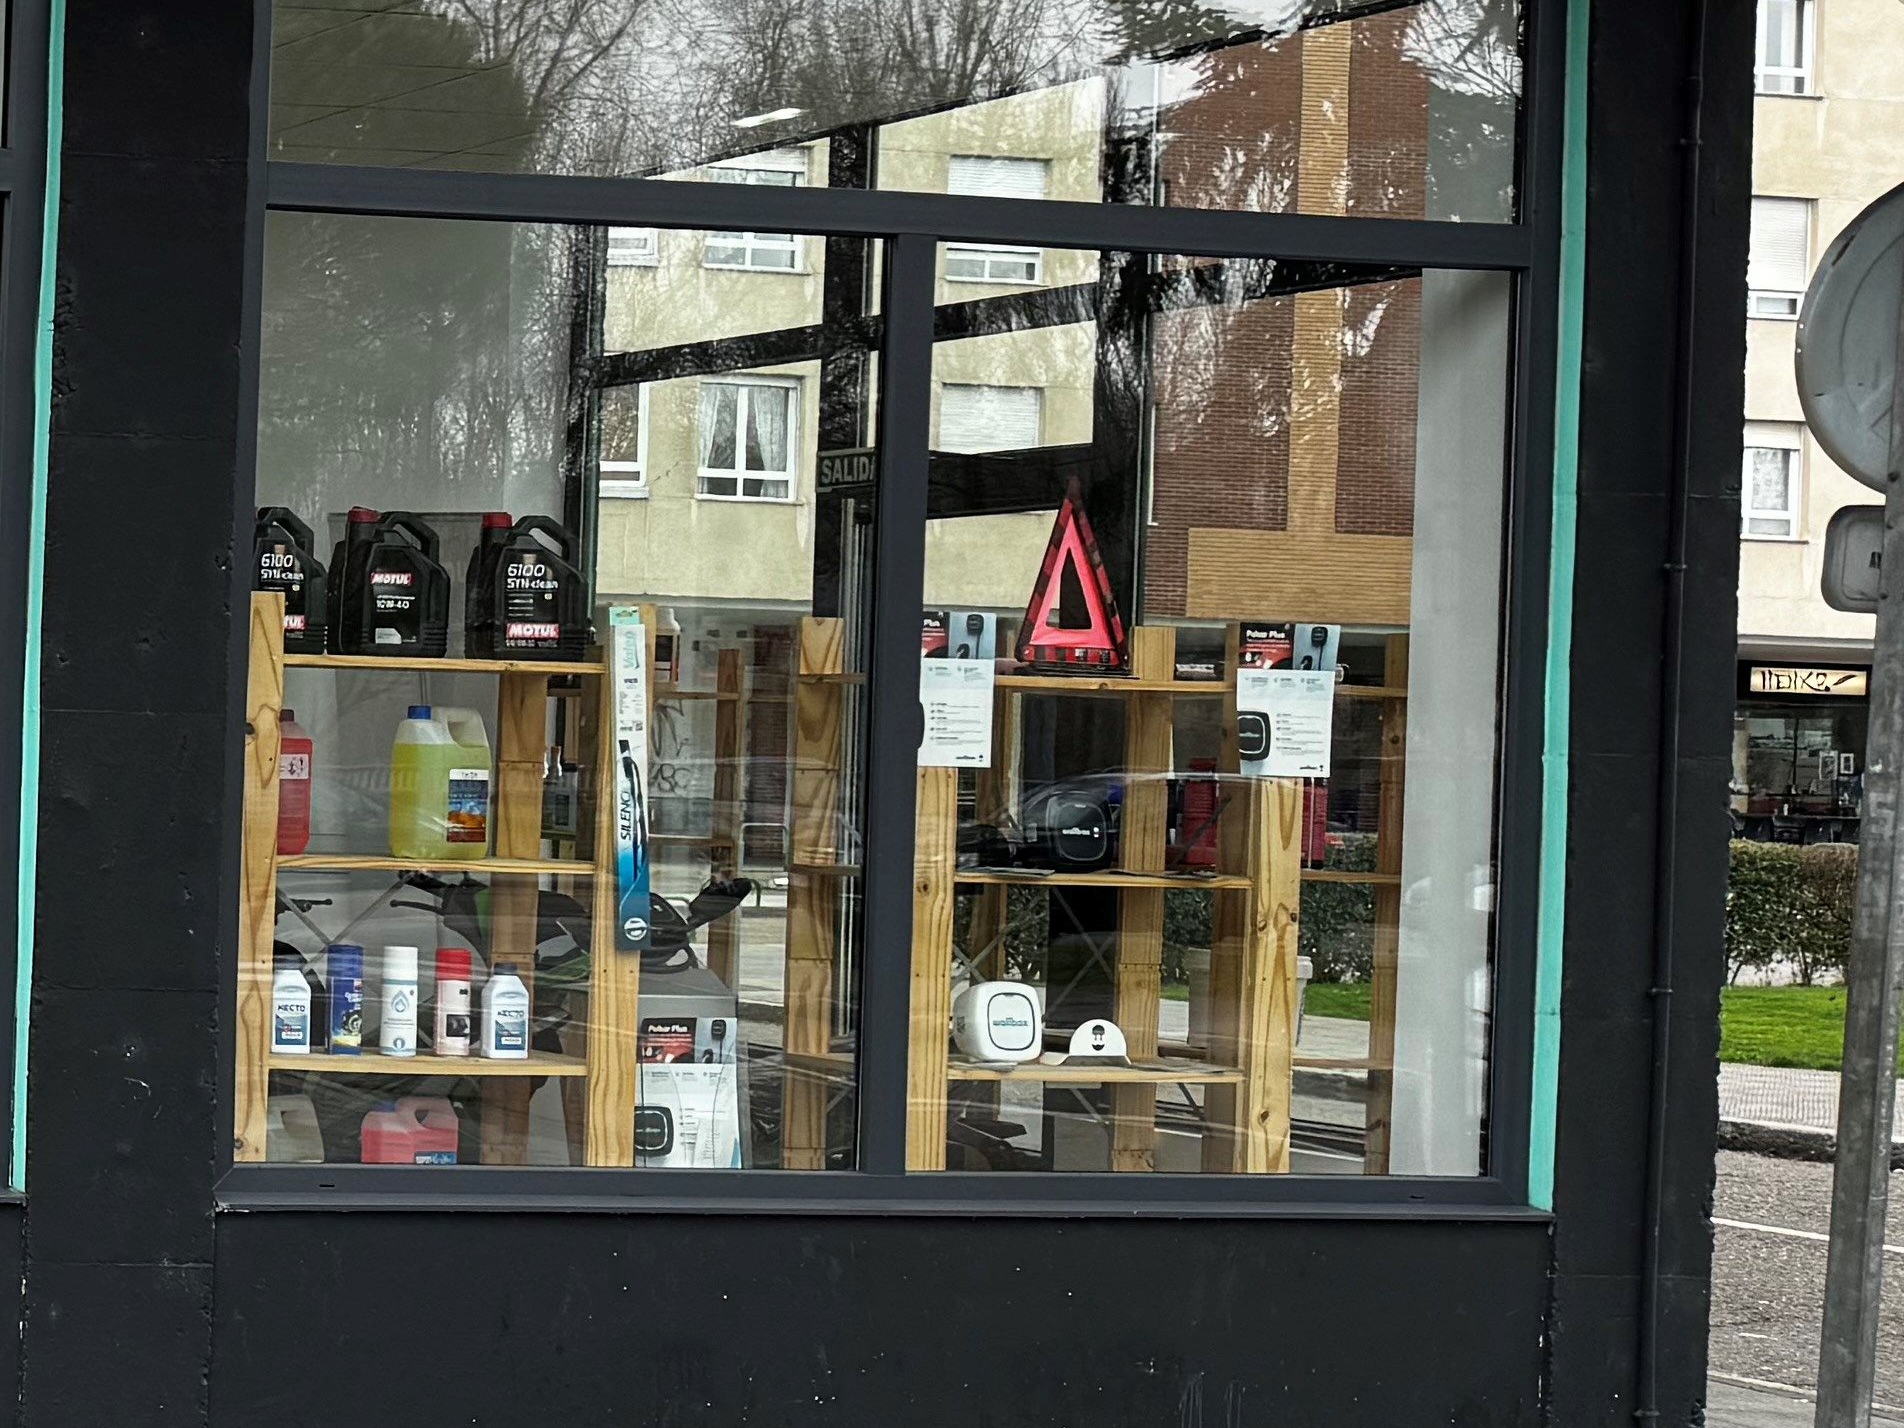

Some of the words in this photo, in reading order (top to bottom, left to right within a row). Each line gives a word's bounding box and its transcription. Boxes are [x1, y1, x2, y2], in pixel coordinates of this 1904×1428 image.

[261, 554, 293, 568] 6100
[508, 564, 545, 576] 6100
[372, 573, 411, 584] MOTUL
[509, 624, 558, 637] MOTUL
